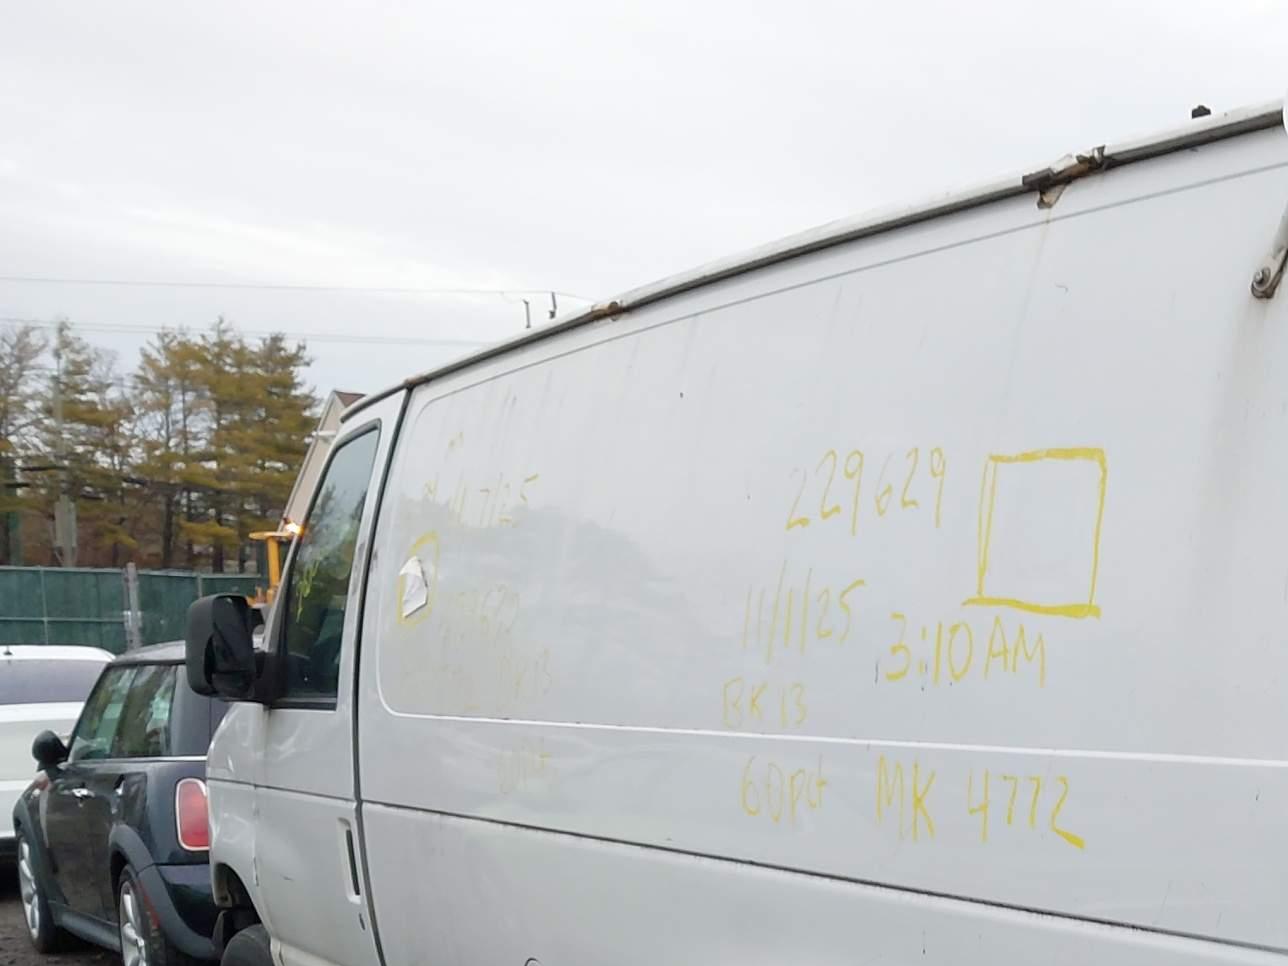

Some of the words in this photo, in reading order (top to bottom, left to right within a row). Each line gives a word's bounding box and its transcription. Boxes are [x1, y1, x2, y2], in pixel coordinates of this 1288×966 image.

[785, 447, 946, 537] 229629
[885, 611, 973, 686] 3:10
[984, 615, 1047, 689] AM
[876, 752, 936, 843] MK
[967, 768, 1085, 849] 4772
